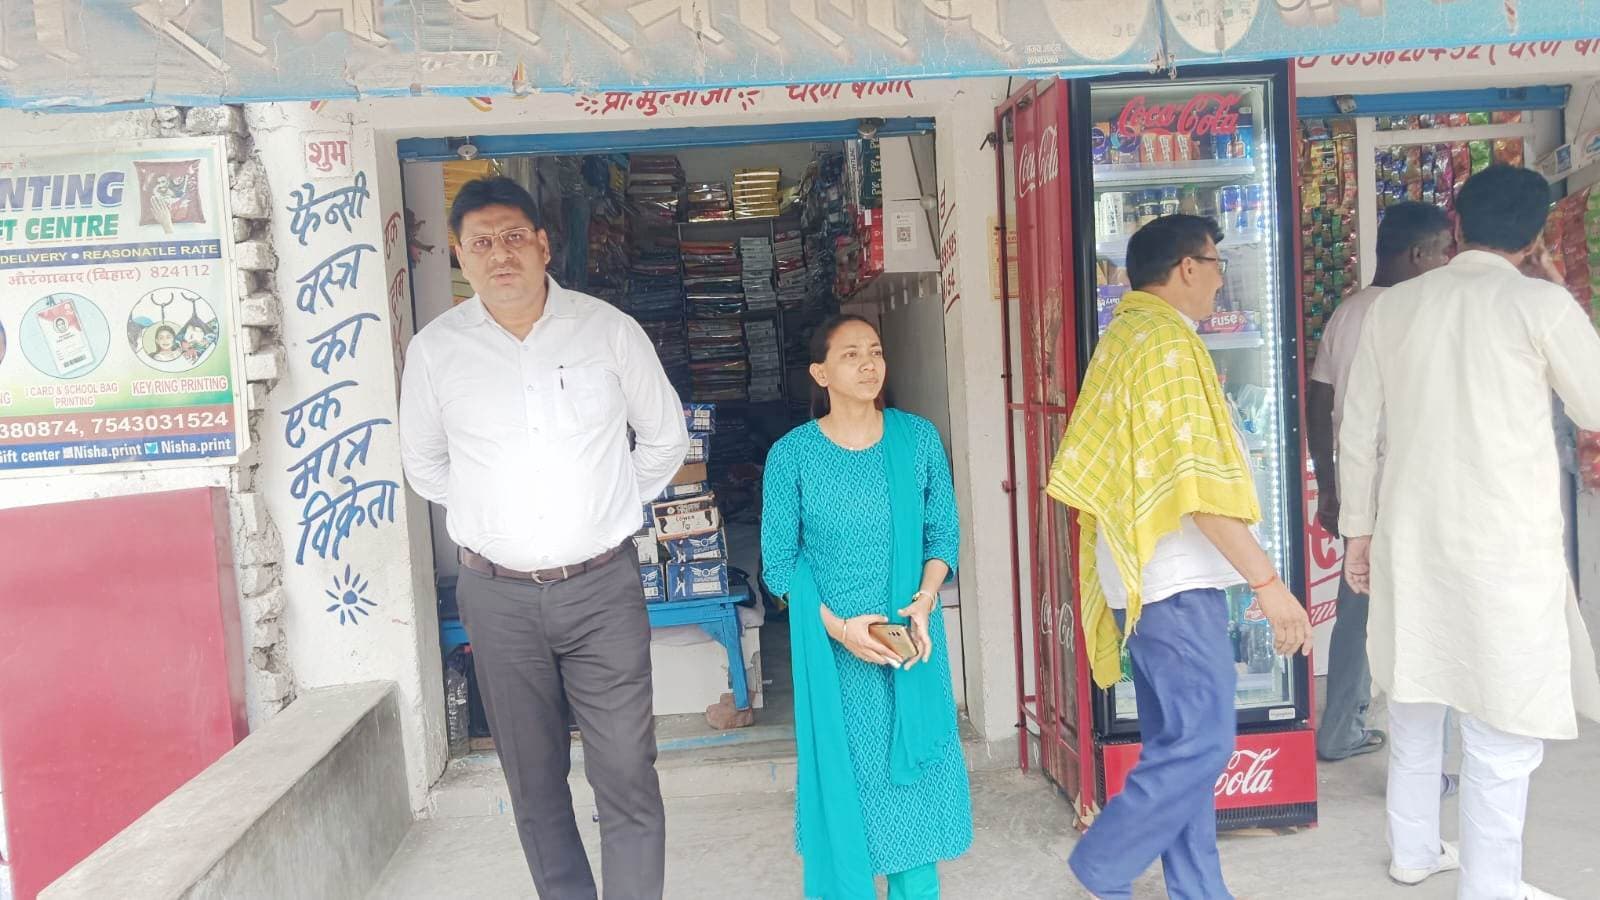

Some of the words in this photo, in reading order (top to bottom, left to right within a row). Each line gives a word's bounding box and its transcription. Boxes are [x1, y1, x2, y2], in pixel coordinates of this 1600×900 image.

[25, 213, 119, 241] CENTRE
[0, 251, 67, 265] DELIVERY
[83, 246, 177, 260] REASONATLE
[180, 244, 218, 256] RATE
[150, 264, 210, 279] 824112
[306, 312, 381, 374] का
[30, 386, 55, 397] CARD
[64, 383, 98, 395] SCHOOL
[100, 382, 118, 394] BAG
[132, 380, 152, 394] KEY
[154, 379, 179, 393] RING
[181, 376, 228, 392] PRINTING
[55, 396, 94, 408] PRINTING
[92, 411, 229, 434] 7543031524
[281, 380, 359, 448] एक
[21, 448, 60, 462] center
[73, 444, 142, 459] Nisha.print
[161, 438, 231, 456] Nisha.print
[286, 418, 392, 499] मात्र
[295, 475, 400, 565] विक्रेता
